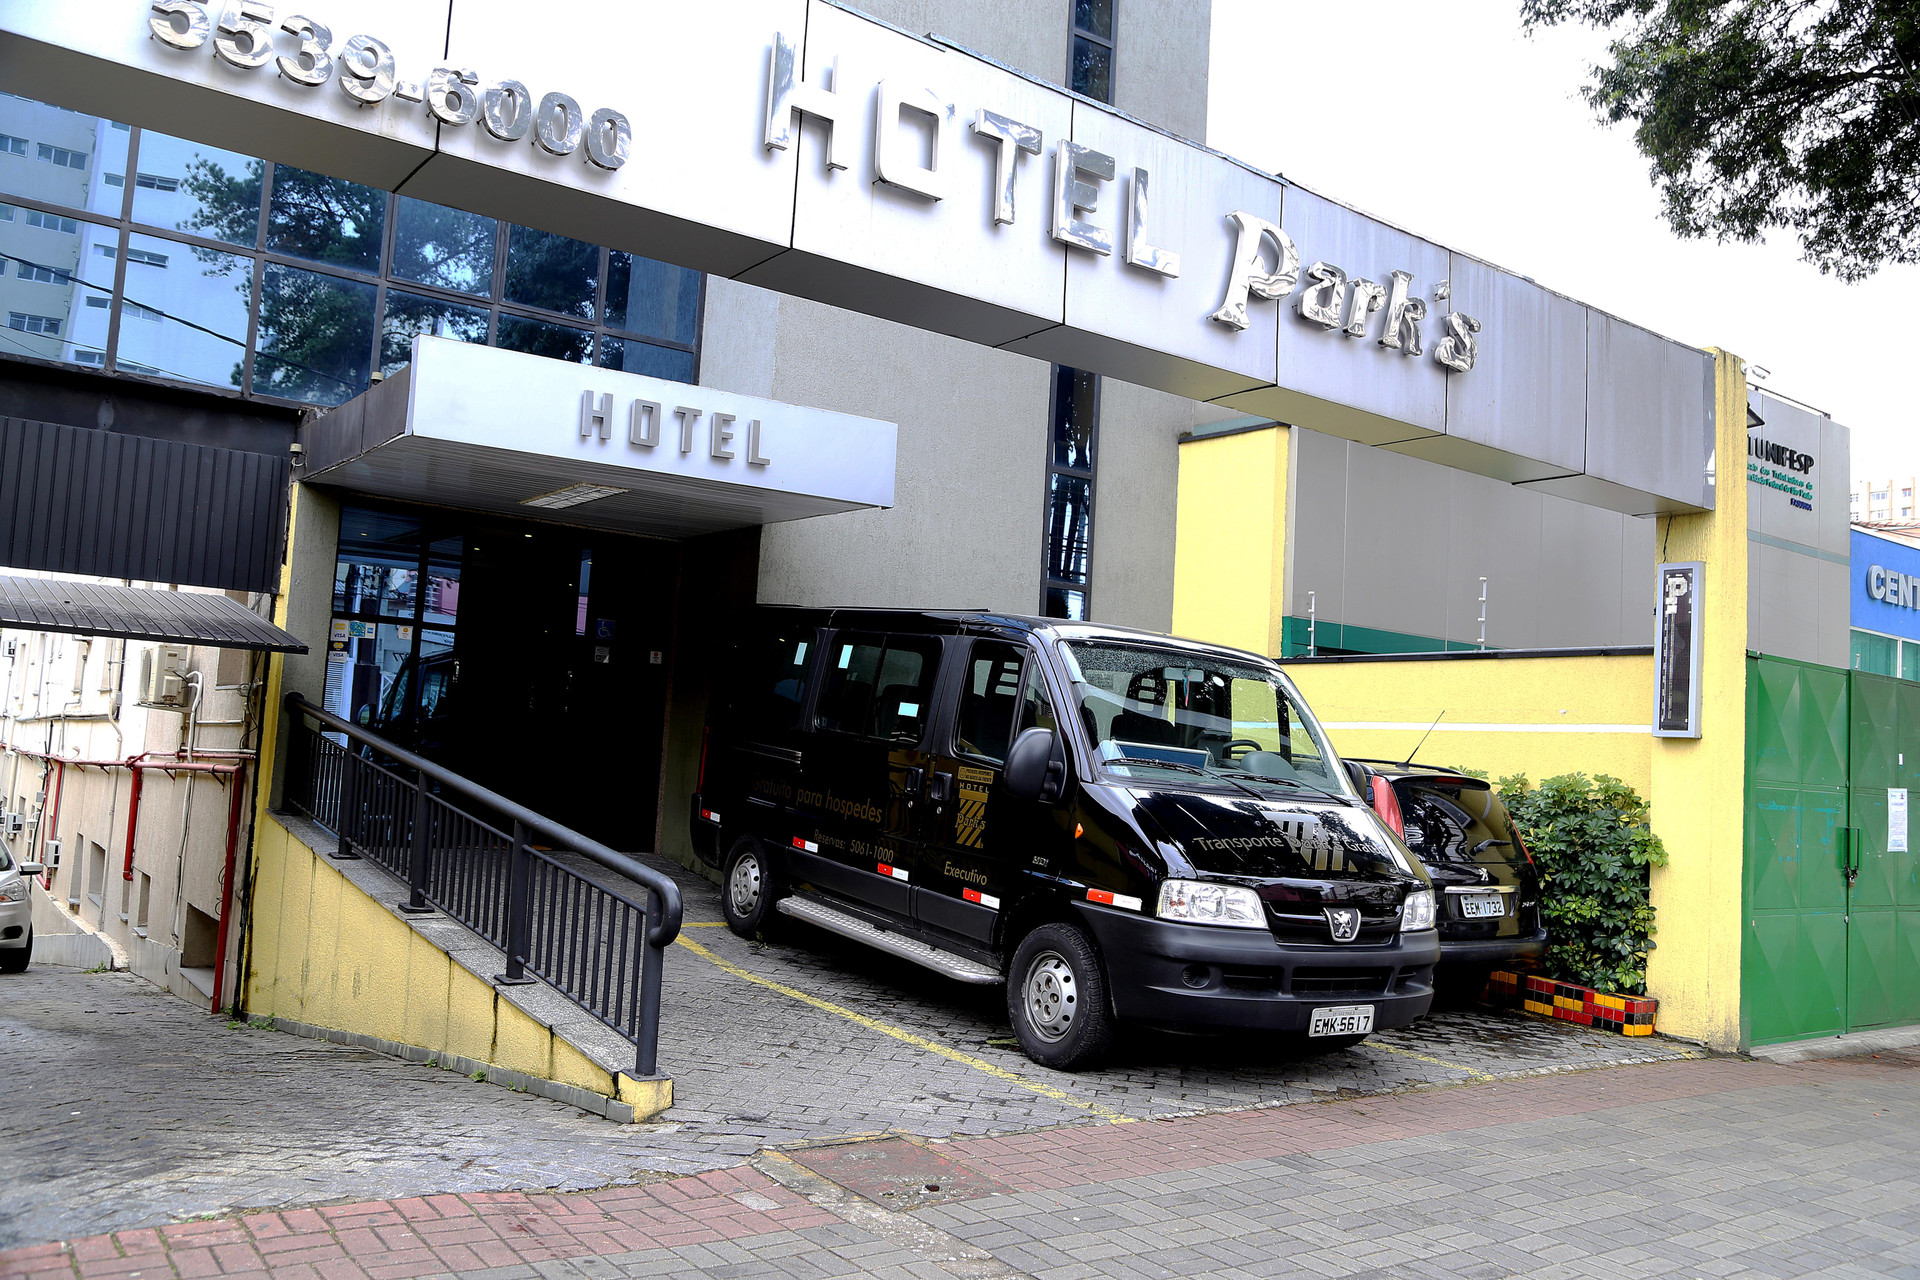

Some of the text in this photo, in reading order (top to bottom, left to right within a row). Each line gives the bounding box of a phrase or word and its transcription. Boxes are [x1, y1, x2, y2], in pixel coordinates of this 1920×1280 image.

[146, 0, 632, 172] 5539-6000
[764, 30, 1482, 374] HOTEL Park's
[580, 390, 771, 466] HOTEL
[796, 788, 823, 806] para
[825, 786, 883, 824] hospedes
[959, 782, 990, 794] HOTEL
[814, 828, 894, 863] Reservas: 5061-1000
[1192, 835, 1285, 852] Transporte
[943, 861, 988, 886] Executivo
